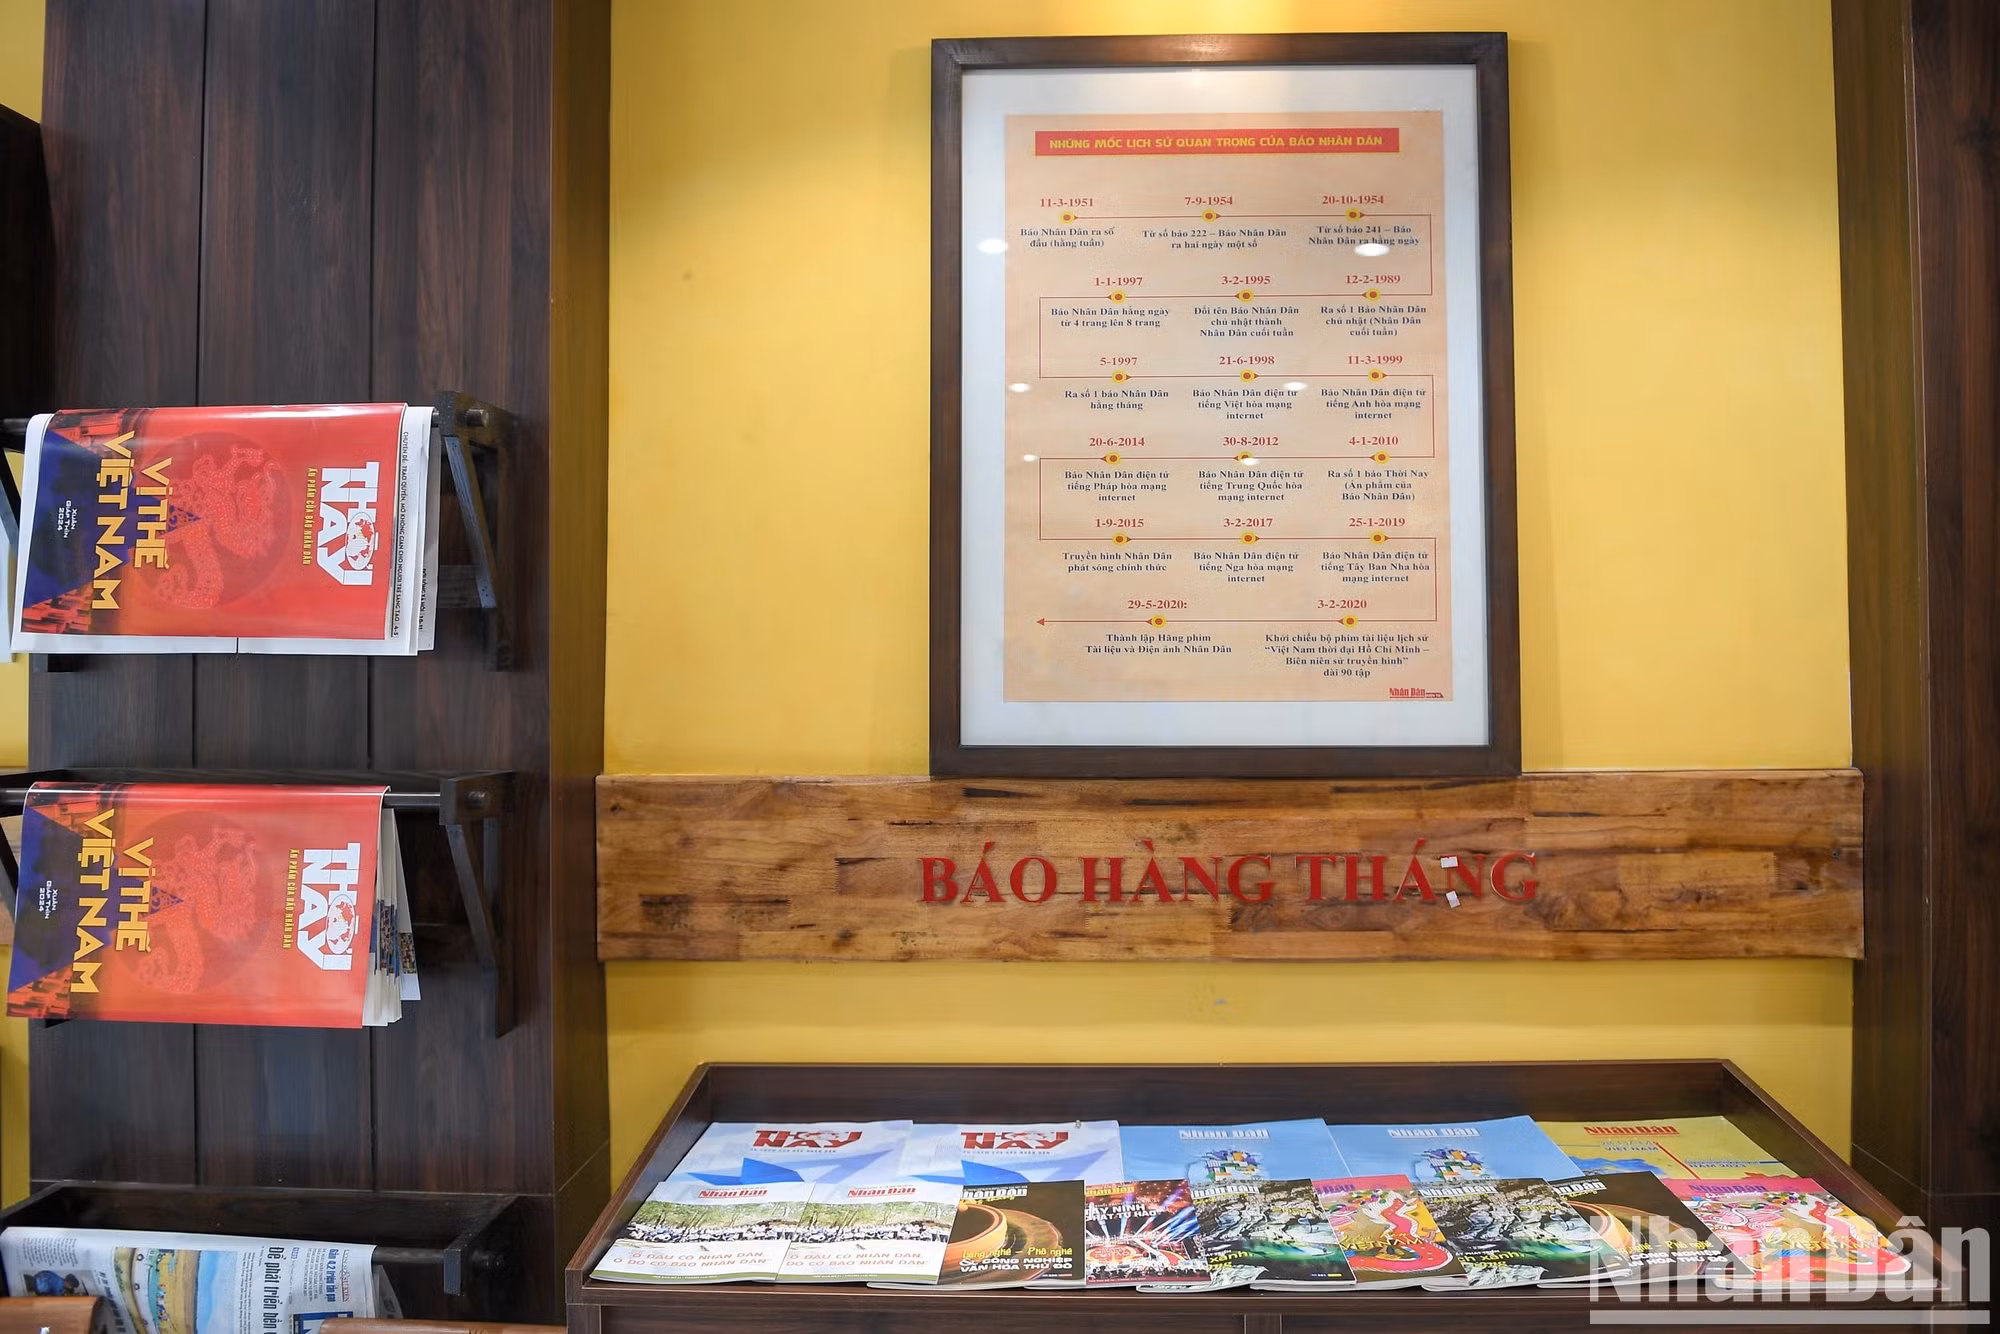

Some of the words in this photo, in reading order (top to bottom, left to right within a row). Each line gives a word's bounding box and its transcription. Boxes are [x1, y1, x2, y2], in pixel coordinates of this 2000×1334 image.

[1041, 198, 1093, 207] 11-3-1951
[1184, 196, 1233, 206] 7-9-1954
[1322, 195, 1384, 205] 20-10-1954
[1020, 228, 1039, 236] Báo
[1041, 228, 1067, 236] Nhân
[1069, 228, 1089, 236] Dân
[1104, 226, 1115, 235] số
[1029, 238, 1048, 247] đầu
[1050, 239, 1077, 248] (hằng
[1079, 238, 1105, 247] tuần)
[1184, 241, 1199, 249] hai
[1201, 240, 1223, 250] ngày
[1227, 240, 1245, 250] một
[1247, 238, 1258, 248] số
[1096, 277, 1143, 286] 1-1-1997
[1221, 275, 1271, 285] 3-2-1995
[1346, 275, 1401, 284] 12-2-1989
[1061, 319, 1071, 327] từ
[1082, 320, 1107, 328] trang
[1110, 318, 1124, 327] lên
[1135, 320, 1161, 328] trang
[1200, 329, 1225, 337] Nhân
[1228, 329, 1247, 337] Dân
[1250, 328, 1270, 337] cuối
[1272, 326, 1294, 337] tuần
[1100, 357, 1138, 366] 5-1997
[1219, 356, 1275, 365] 21-6-1998
[1348, 355, 1403, 365] 11-3-1999
[1089, 437, 1145, 447] 20-6-2014
[1223, 436, 1279, 446] 30-8-2012
[1348, 436, 1399, 446] 4-1-2010
[96, 430, 135, 510] VIỆT
[135, 458, 173, 495] VỊ
[57, 507, 65, 531] 2024
[1096, 518, 1144, 528] 1-9-2015
[1223, 518, 1273, 528] 3-2-2017
[1349, 517, 1406, 527] 25-1-2019
[317, 468, 351, 585] NAY
[134, 499, 170, 570] THẾ
[1063, 550, 1097, 562] Truyền
[1100, 552, 1121, 560] hình
[1124, 552, 1150, 560] Nhân
[1153, 552, 1172, 560] Dân
[91, 517, 125, 609] NAM
[1068, 563, 1089, 573] phát
[1092, 563, 1114, 573] sóng
[1116, 563, 1143, 571] chính
[1145, 563, 1167, 571] thức
[1127, 599, 1187, 609] 29-5-2020:
[1317, 599, 1367, 609] 3-2-2020
[1107, 634, 1137, 642] Thành
[1140, 633, 1155, 644] lập
[1158, 634, 1184, 643] Hãng
[1186, 634, 1211, 644] phim
[1086, 645, 1101, 653] Tài
[1104, 645, 1121, 655] liệu
[1124, 645, 1135, 653] và
[1138, 645, 1160, 655] Điện
[1163, 645, 1181, 653] ảnh
[1184, 645, 1209, 653] Nhân
[1212, 645, 1232, 653] Dân
[1323, 668, 1338, 677] dài
[1355, 668, 1371, 678] tập
[78, 808, 116, 891] VIỆT
[118, 838, 155, 877] VỊ
[917, 841, 1058, 904] BÁO
[1081, 839, 1275, 904] HÀNG
[1295, 838, 1539, 902] THÁNG
[297, 849, 332, 970] NAY
[115, 880, 151, 953] THẾ
[70, 897, 108, 992] NAM
[267, 1247, 287, 1260] Để
[264, 1262, 281, 1283] phát
[263, 1286, 283, 1309] triển
[263, 1313, 283, 1329] bền
